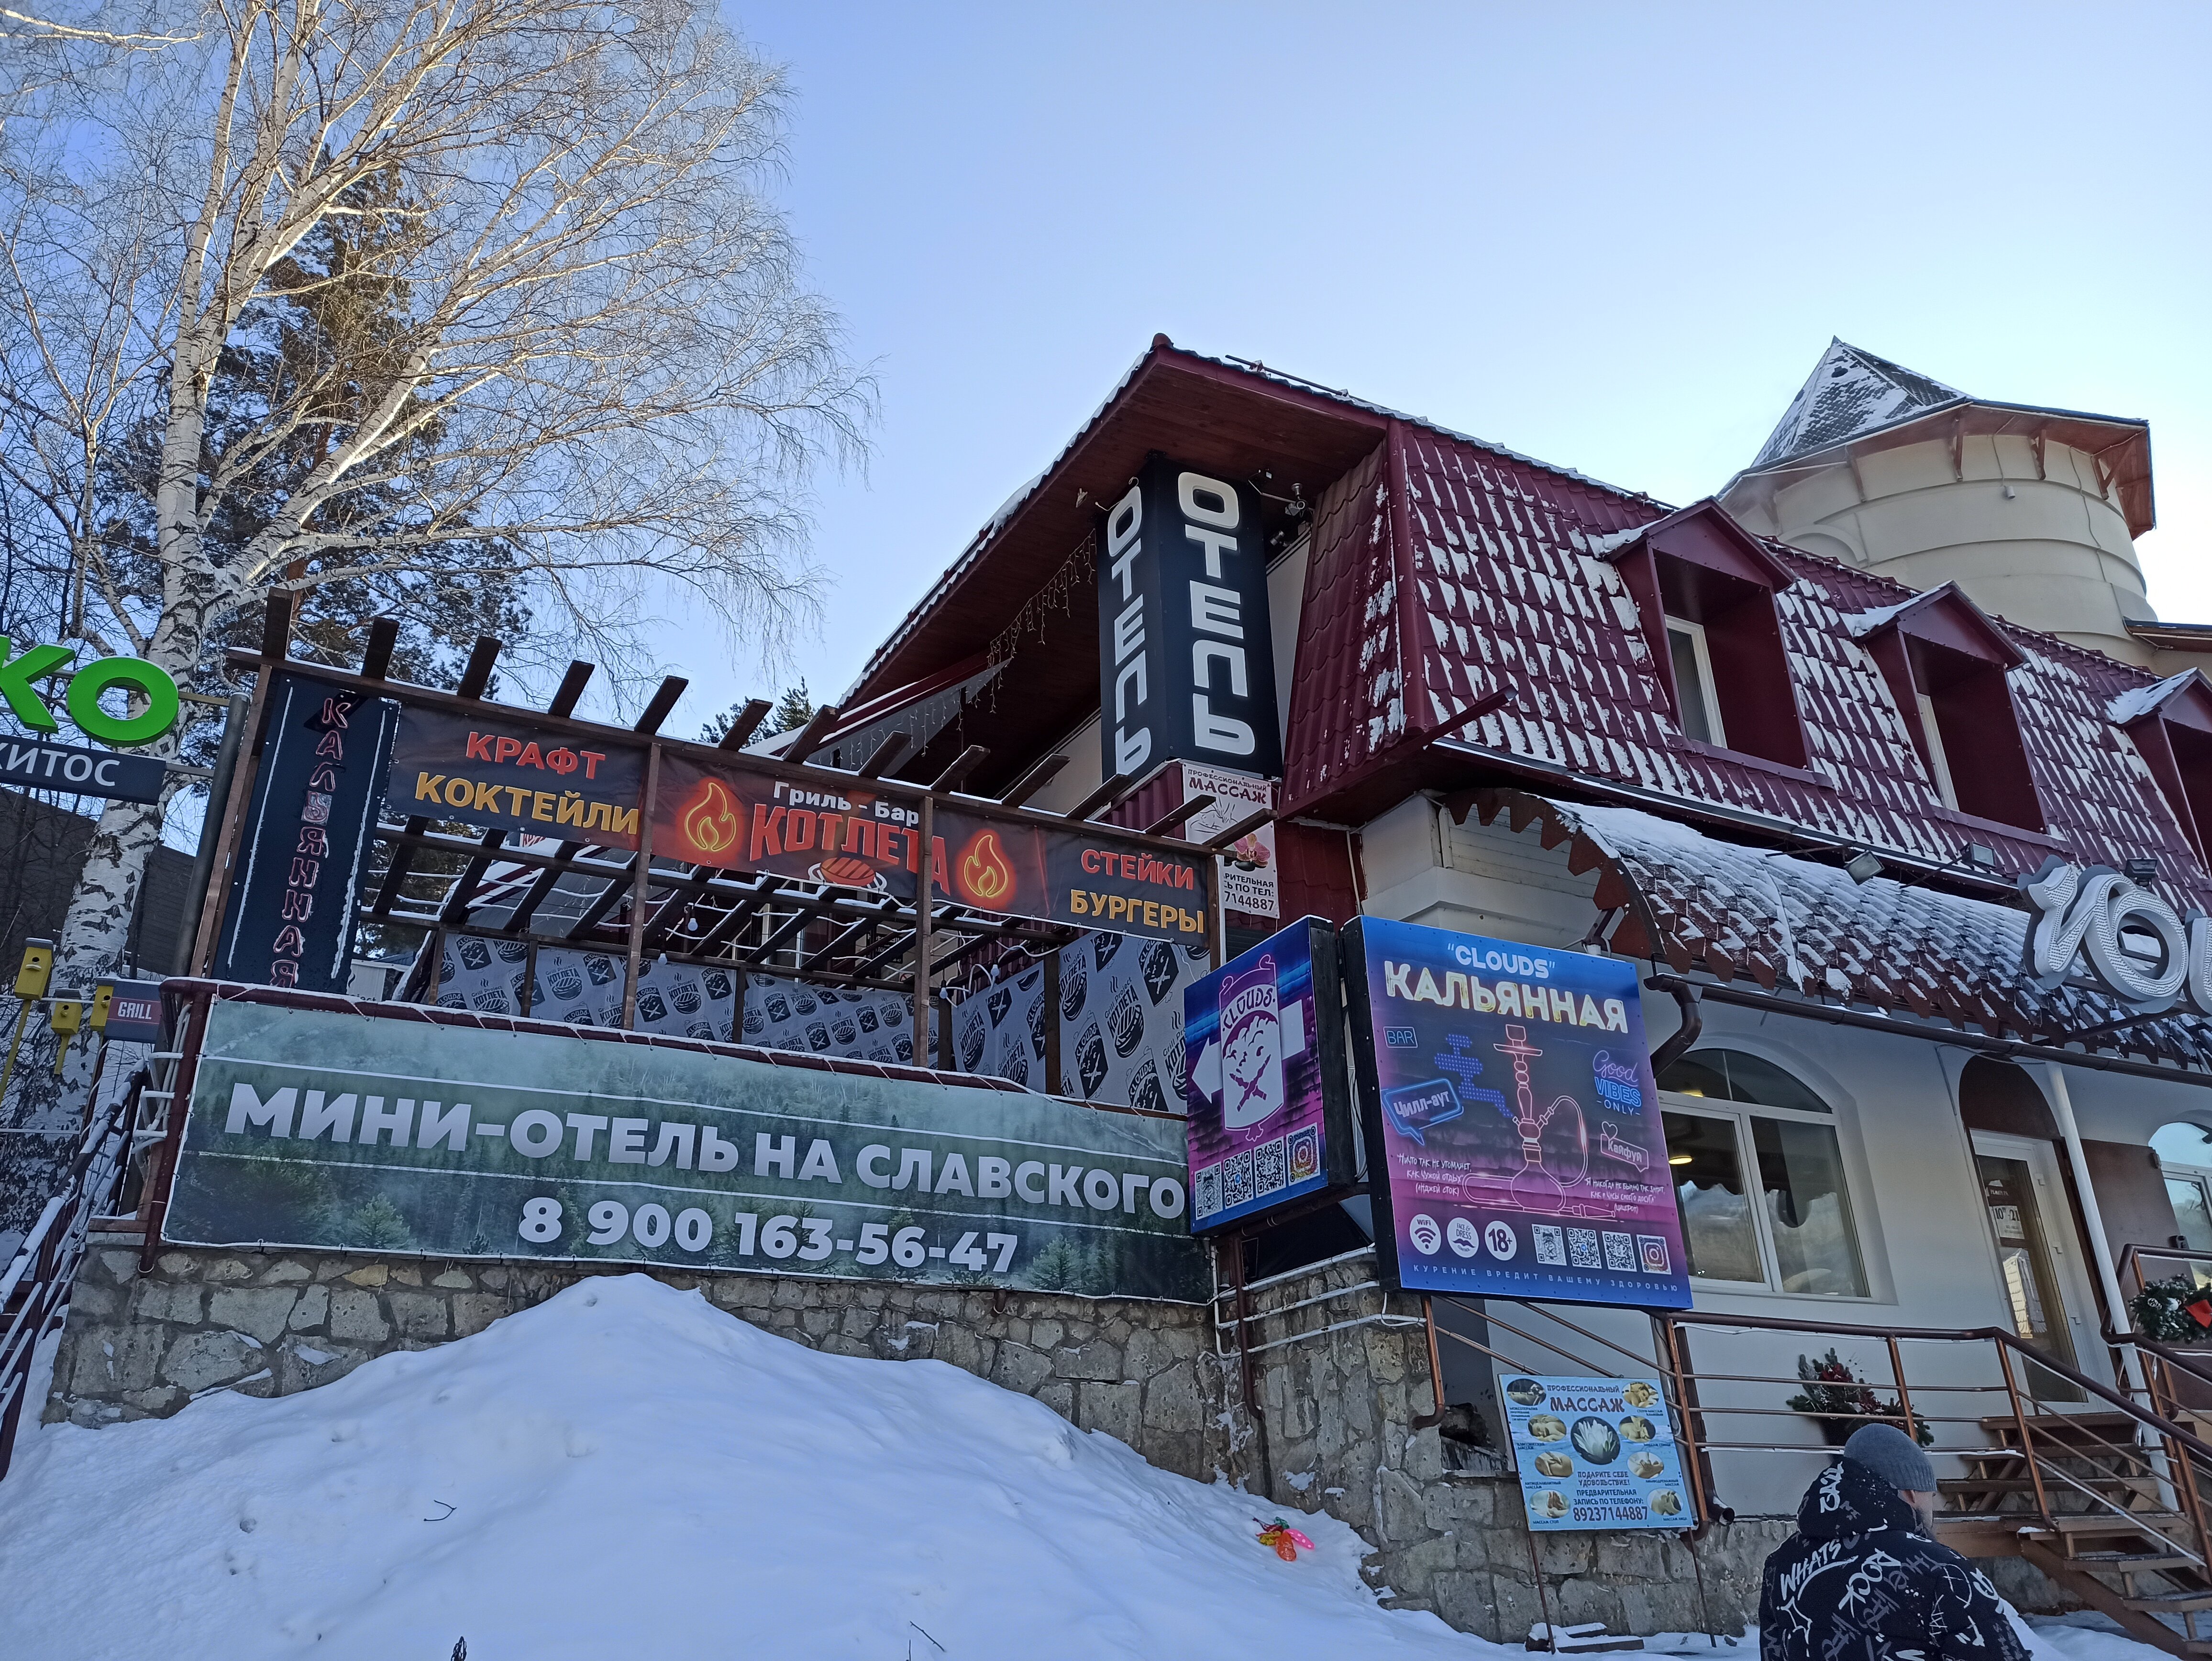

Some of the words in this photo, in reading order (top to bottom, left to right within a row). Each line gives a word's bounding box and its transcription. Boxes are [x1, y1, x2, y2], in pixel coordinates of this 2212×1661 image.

[1178, 472, 1255, 755] ОТЕЛЬ
[1108, 486, 1151, 775] ОТЕЛЬ
[466, 731, 606, 779] КРАФТ
[1188, 769, 1267, 792] ПРОФЕССИОНАЛЬНЫЙ
[1189, 777, 1266, 804] МАССАЖ
[415, 772, 639, 835] КОКТЕЙЛИ
[774, 781, 852, 810] Гриль
[875, 801, 918, 827] Бар
[269, 698, 351, 988] КАЛЬЯННАЯ
[750, 803, 951, 896] КОТЛЕТА
[1081, 848, 1194, 890] СТЕЙКИ
[1223, 873, 1274, 888] РИТЕЛЬНАЯ
[1236, 884, 1250, 893] ПО
[1253, 886, 1274, 897] ТЕЛ:
[1070, 889, 1204, 934] БУРГЕРЫ
[118, 1001, 152, 1019] GRILL
[1384, 961, 1628, 1033] КАЛЬЯННАЯ
[1387, 1030, 1415, 1044] BAR
[1593, 1050, 1638, 1082] Good
[1394, 1091, 1449, 1118] Чилл-аут
[1594, 1077, 1642, 1107] VIBES
[224, 1083, 739, 1172] МИНИ-ОТЕЛЬ
[754, 1132, 842, 1184] НА
[856, 1144, 1185, 1219] СЛАВСКОГО
[1419, 1157, 1430, 1167] ТАК
[1432, 1159, 1439, 1169] НЕ
[1407, 1170, 1419, 1179] КАК
[1421, 1170, 1439, 1181] ЧУЖОЙ
[519, 1197, 562, 1243] 8
[586, 1200, 712, 1252] 900
[735, 1212, 1018, 1273] 163-56-47
[1456, 1229, 1471, 1240] DRESS
[1414, 1265, 1476, 1275] КУРЕНИЕ
[1487, 1270, 1538, 1280] ВРЕДИТ
[1548, 1275, 1600, 1285] ВАШЕМУ
[1611, 1280, 1677, 1291] ЗДОРОВЬЮ
[1547, 1384, 1620, 1393] ПРОФЕССИОНАЛЬНЫЙ
[1550, 1396, 1625, 1412] МАССАЖ
[1579, 1479, 1630, 1487] УДОВОЛЬСТВИЕ!
[1573, 1506, 1648, 1521] 89237144887
[1781, 1539, 1841, 1601] WHATS
